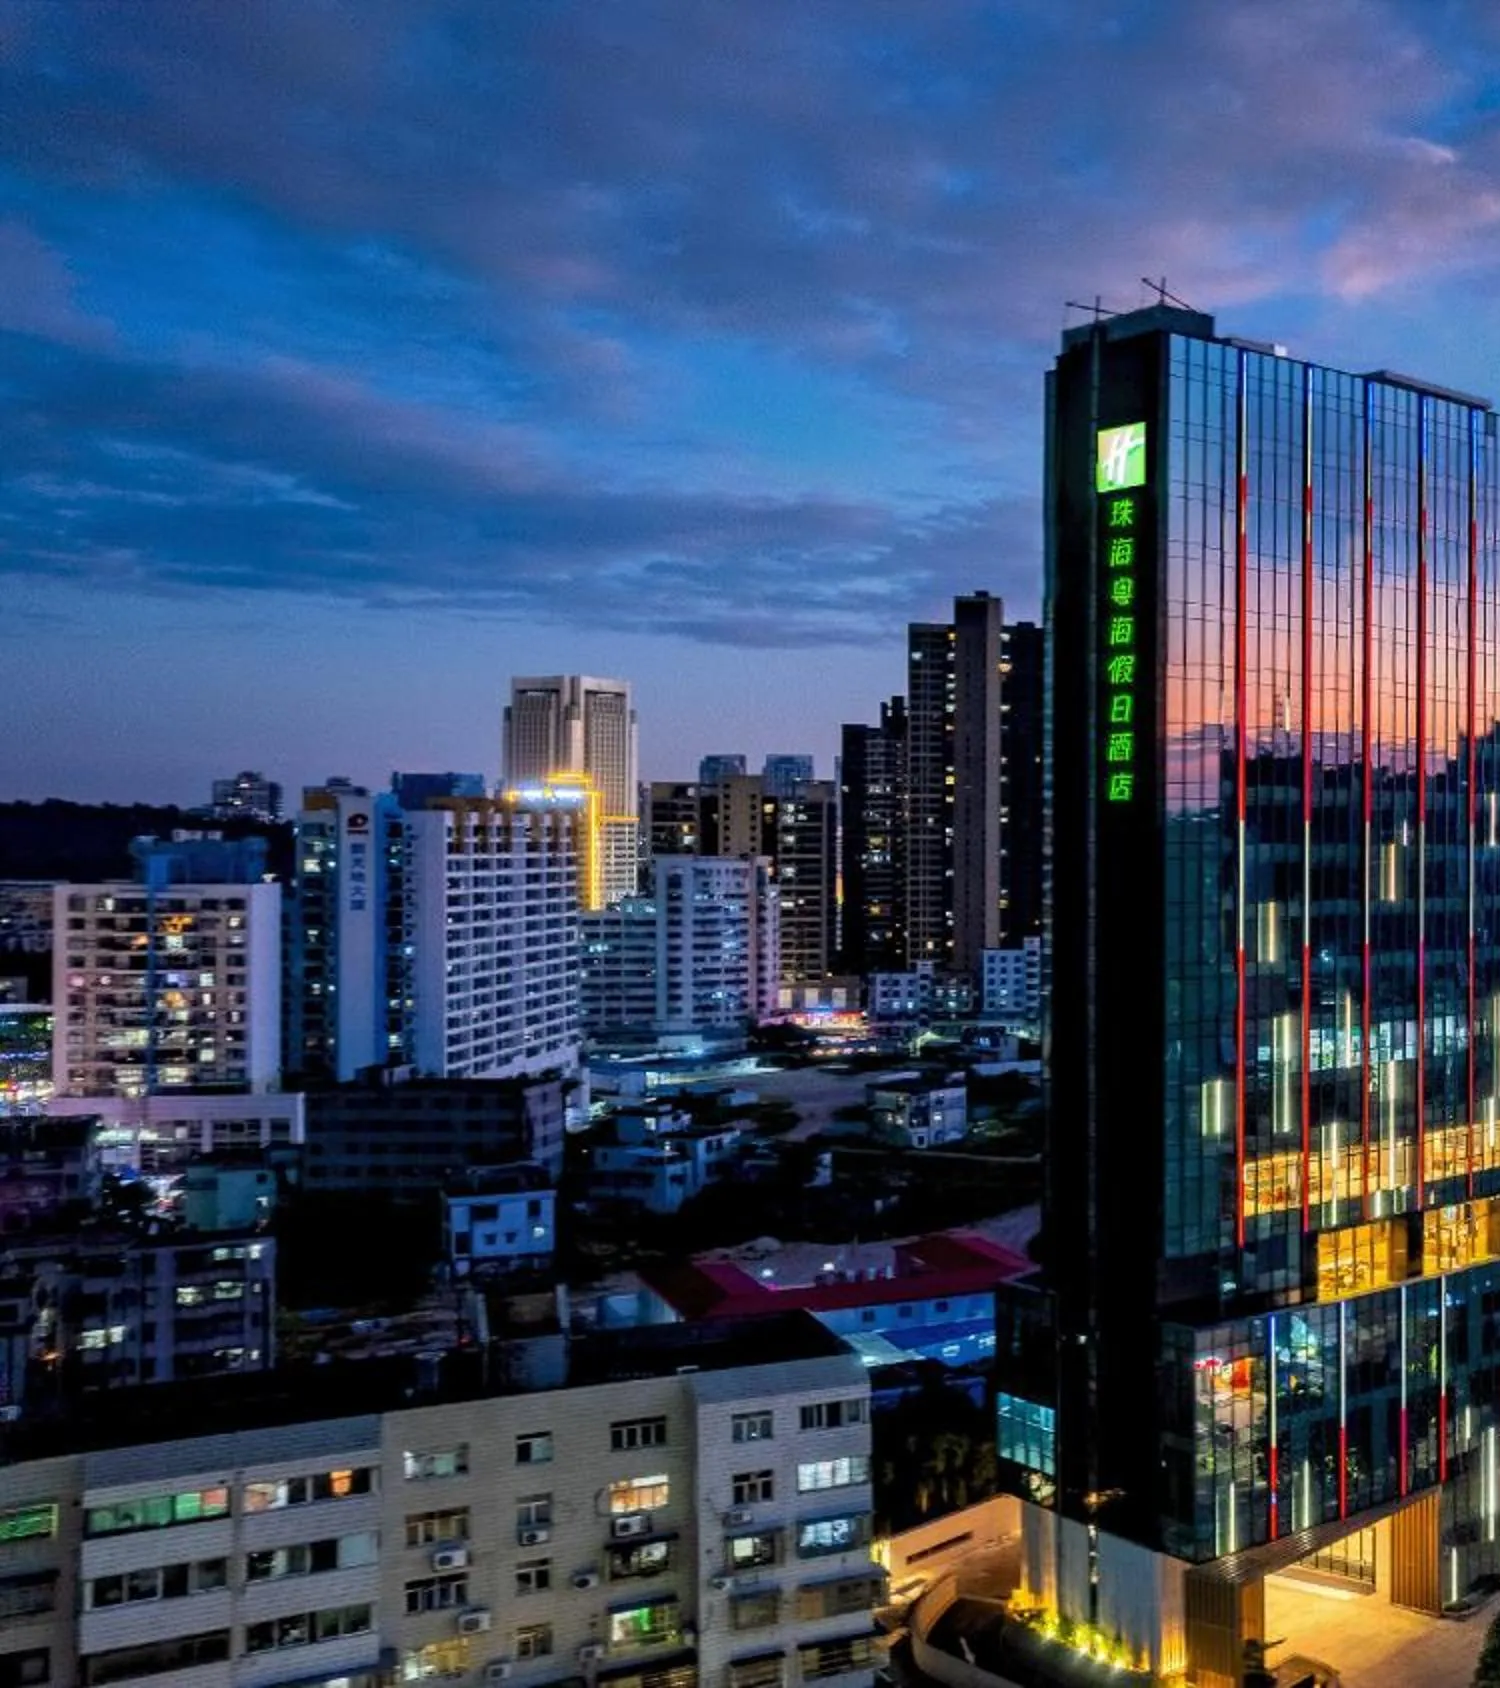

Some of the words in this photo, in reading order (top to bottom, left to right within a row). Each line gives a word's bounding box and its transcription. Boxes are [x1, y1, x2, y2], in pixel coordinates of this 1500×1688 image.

[1108, 498, 1135, 801] 珠海粤海假日酒店
